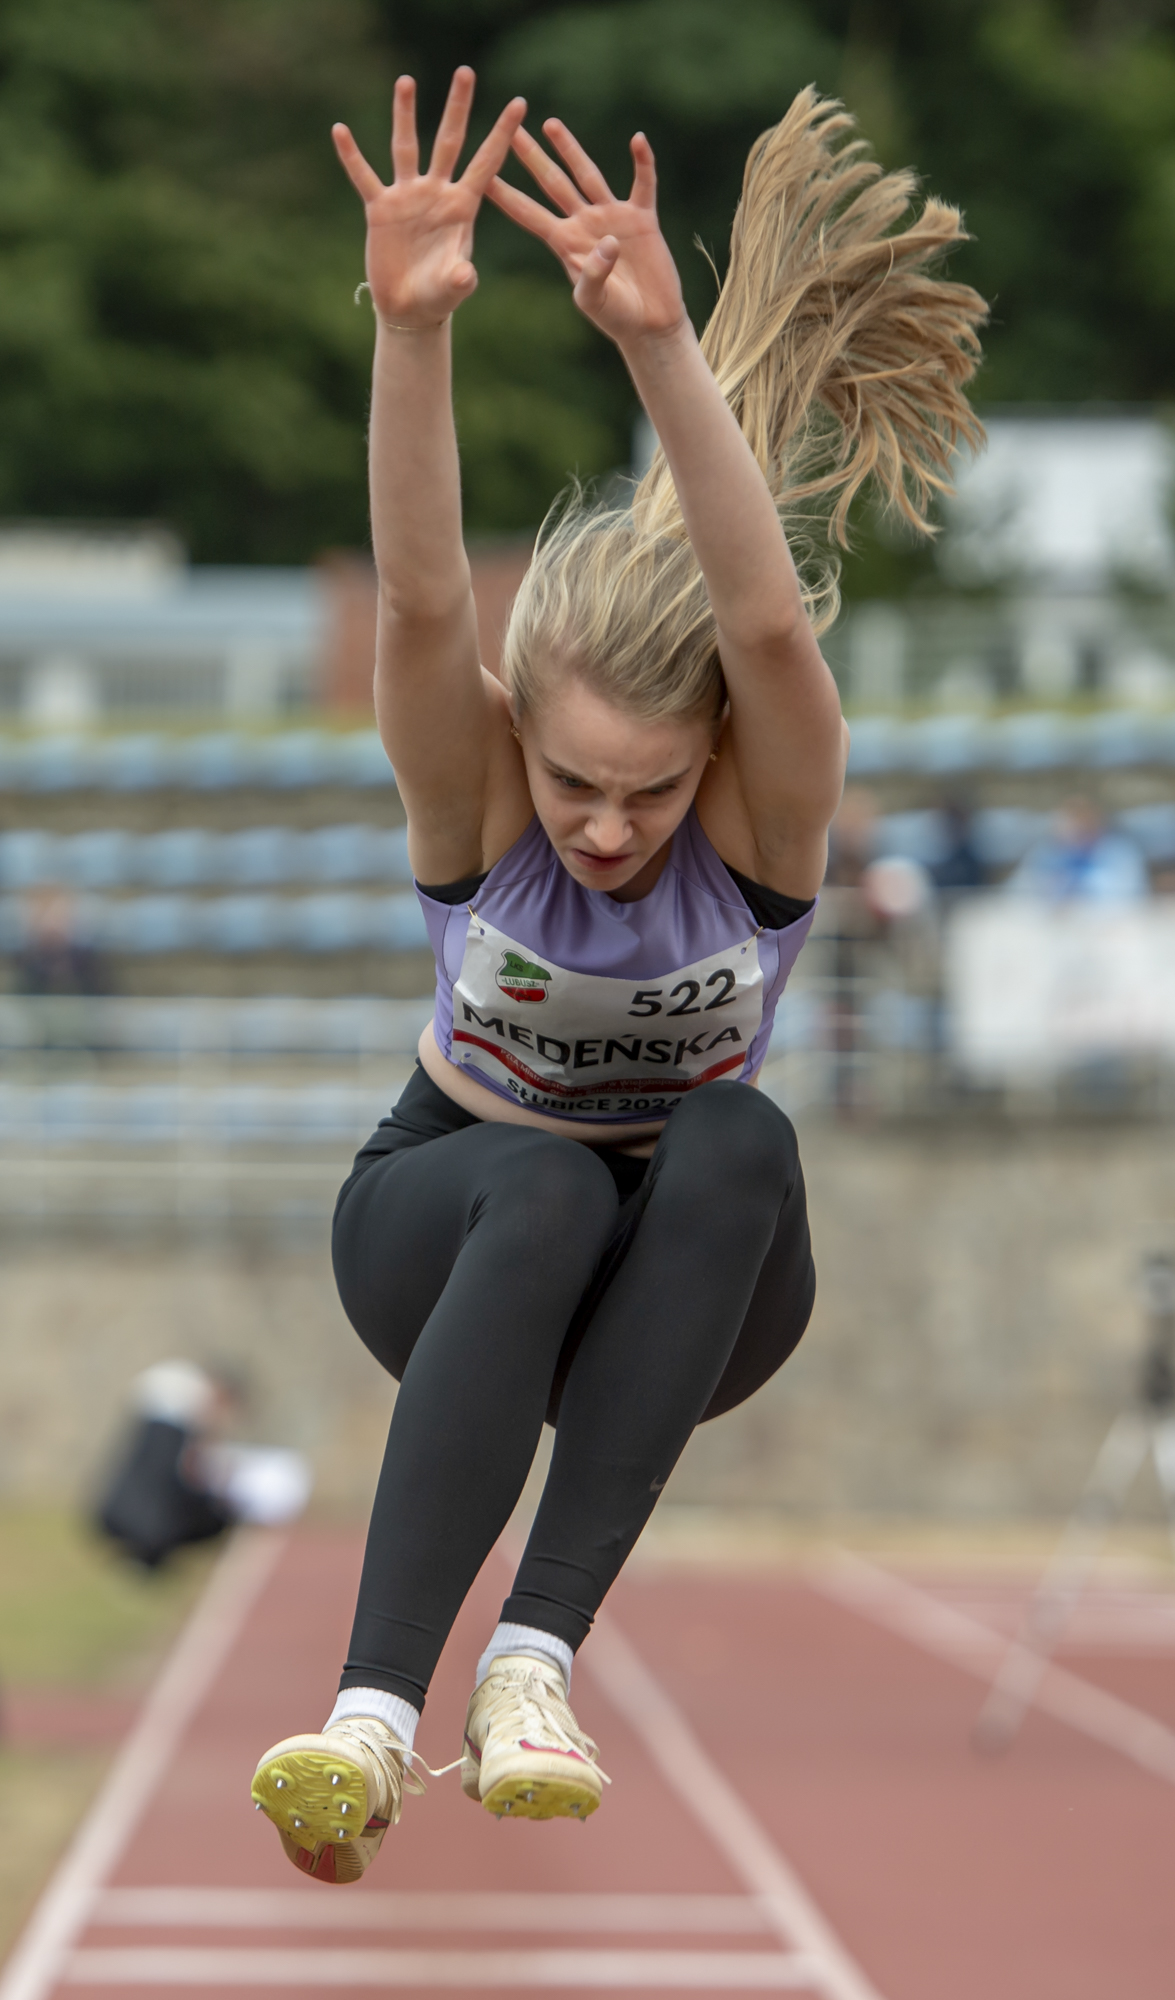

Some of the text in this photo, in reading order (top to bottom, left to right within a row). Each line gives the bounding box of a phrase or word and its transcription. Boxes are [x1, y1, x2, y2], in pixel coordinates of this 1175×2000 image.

[627, 968, 737, 1017] 522
[462, 1002, 743, 1069] MEDEŃSKA
[500, 1048, 519, 1067] PZLA
[506, 1077, 682, 1111] SŁUBICE 2024
